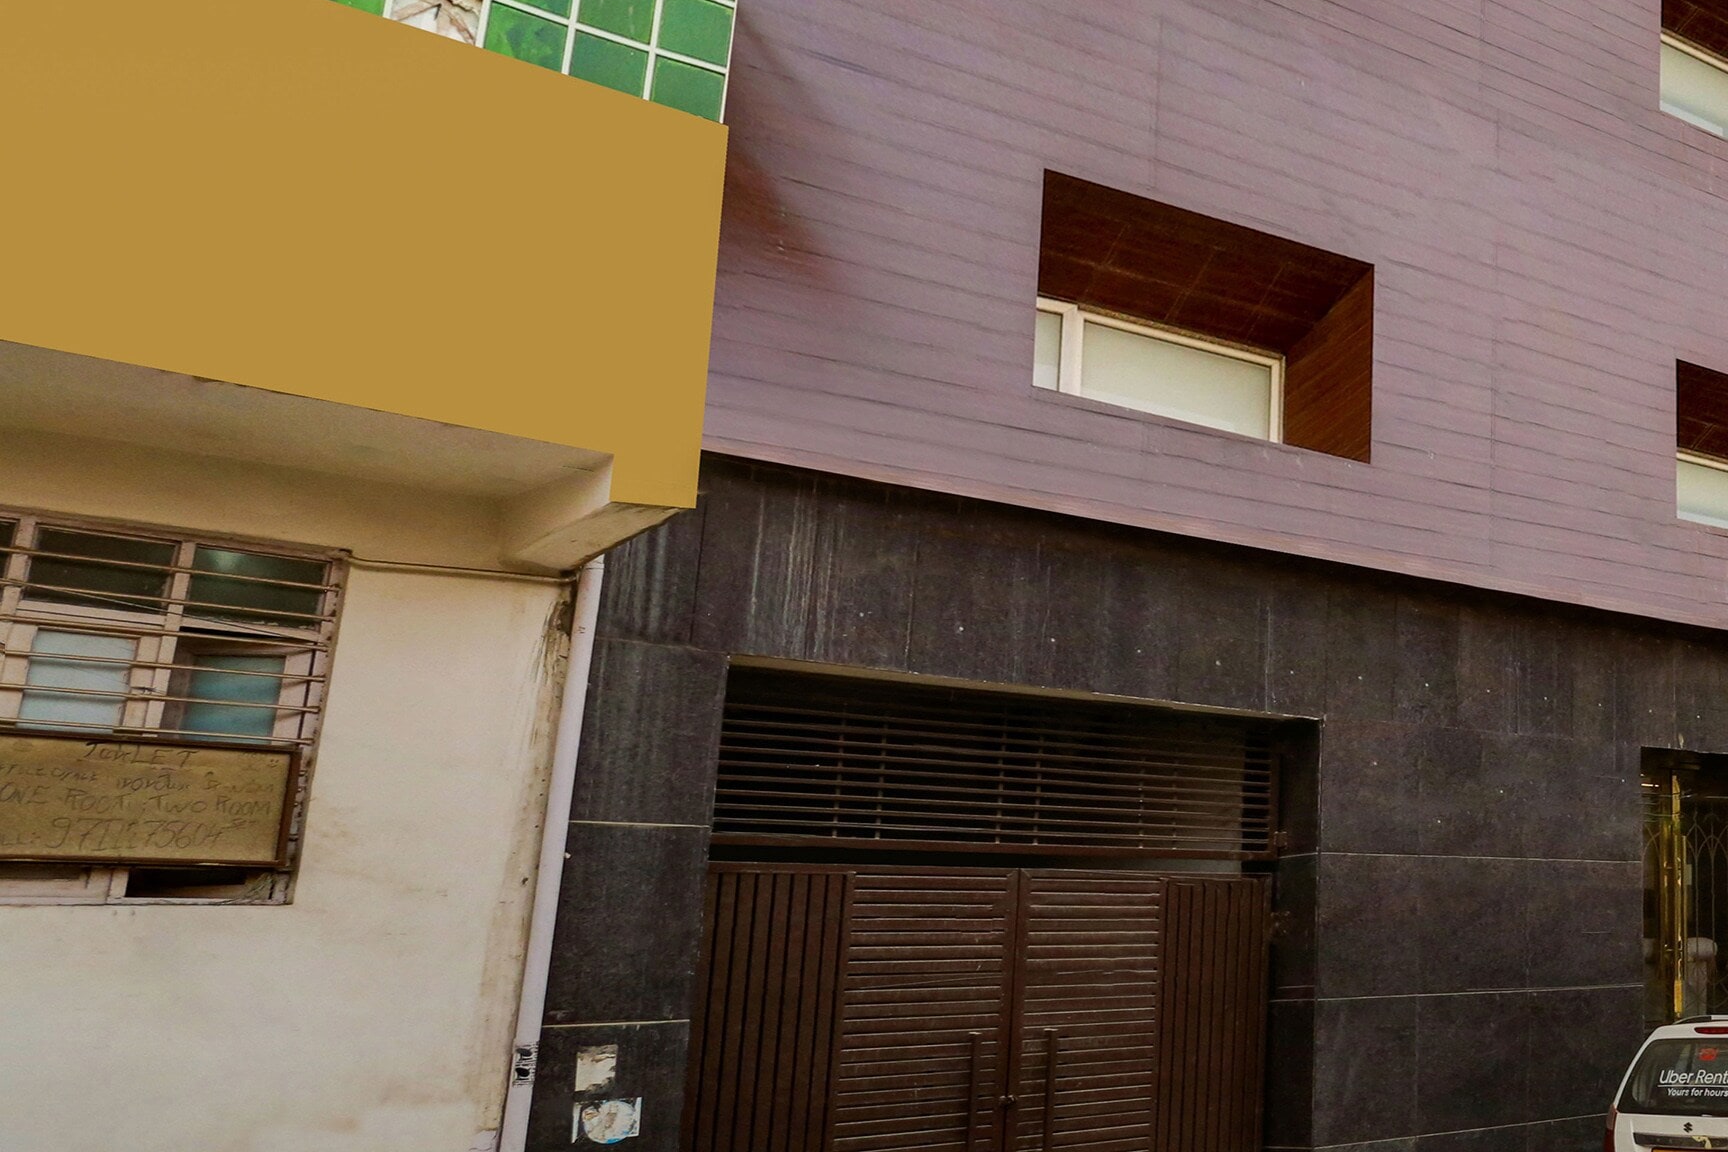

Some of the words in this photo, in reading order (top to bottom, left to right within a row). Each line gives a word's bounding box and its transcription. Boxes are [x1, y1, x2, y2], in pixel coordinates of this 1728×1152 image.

[1659, 1069, 1694, 1084] Uber
[1667, 1088, 1690, 1097] Yours
[1690, 1087, 1704, 1097] for
